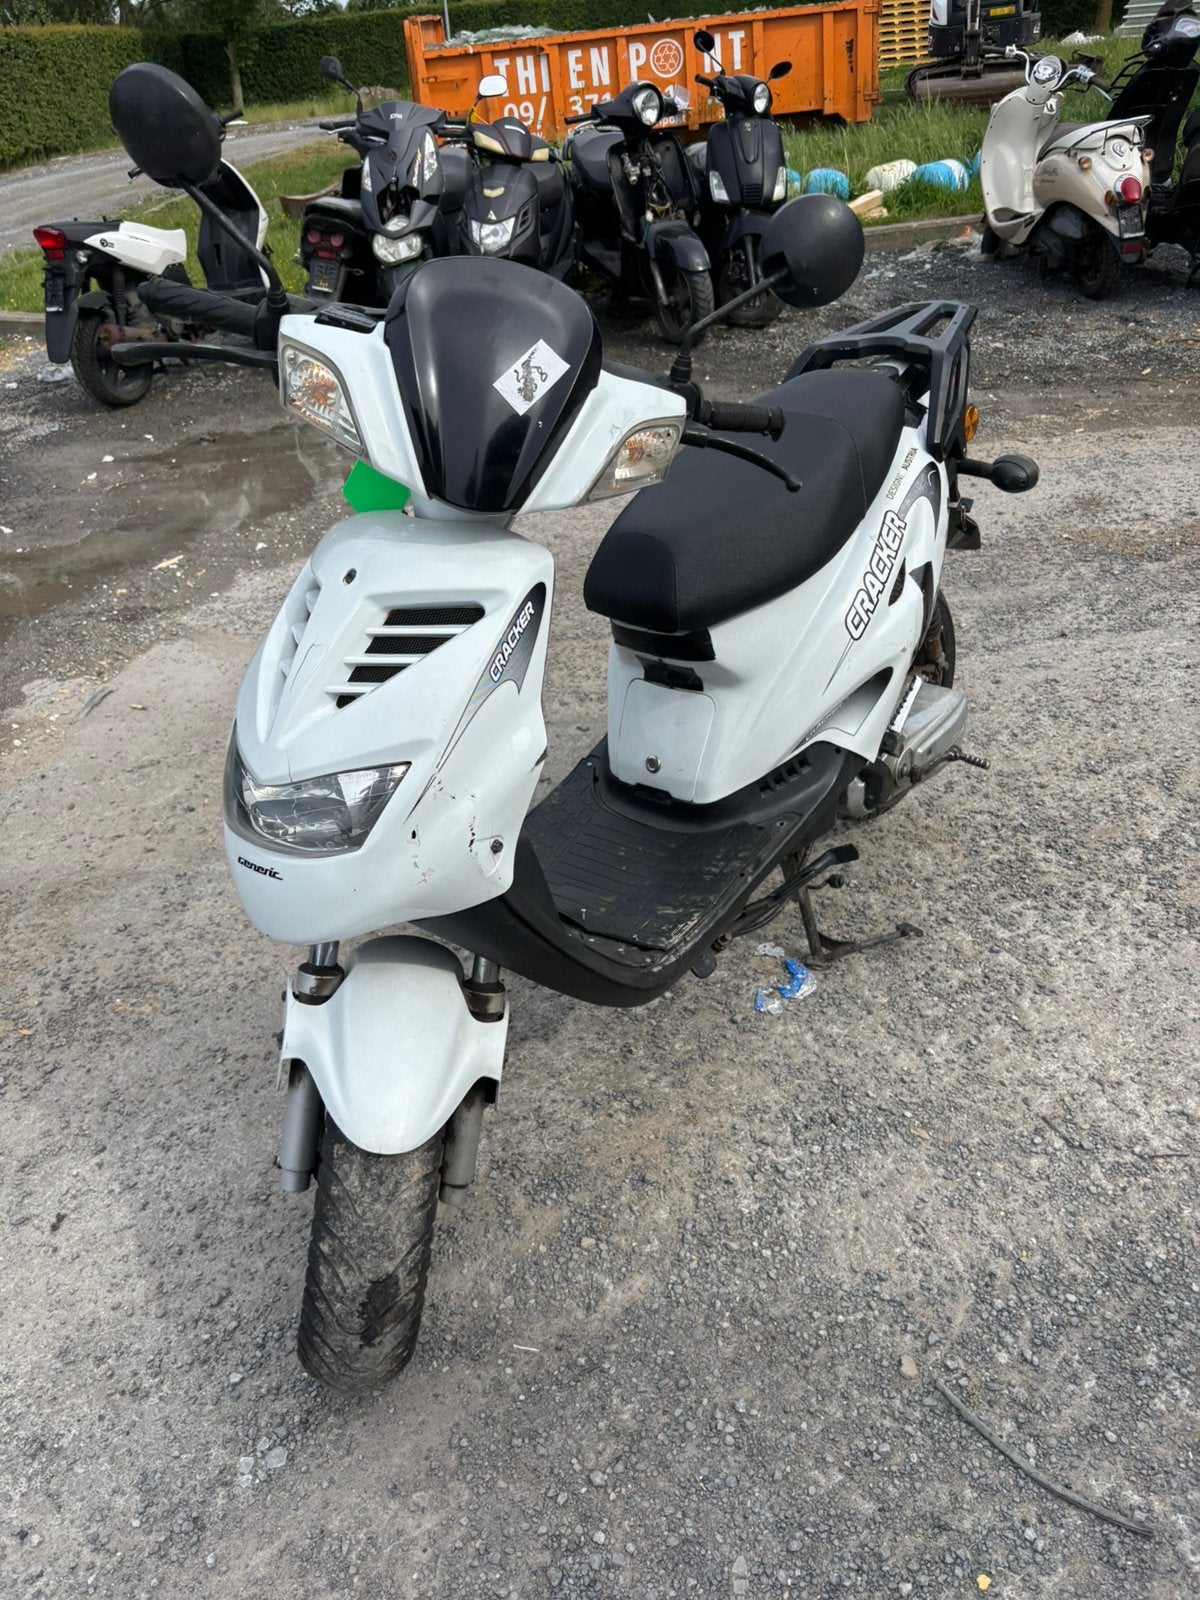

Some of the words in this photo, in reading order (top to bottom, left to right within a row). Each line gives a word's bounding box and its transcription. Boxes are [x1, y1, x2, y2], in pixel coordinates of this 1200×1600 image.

[901, 447, 919, 471] AUSTRIA
[845, 510, 907, 641] CRACKER
[489, 601, 535, 684] CRACKER
